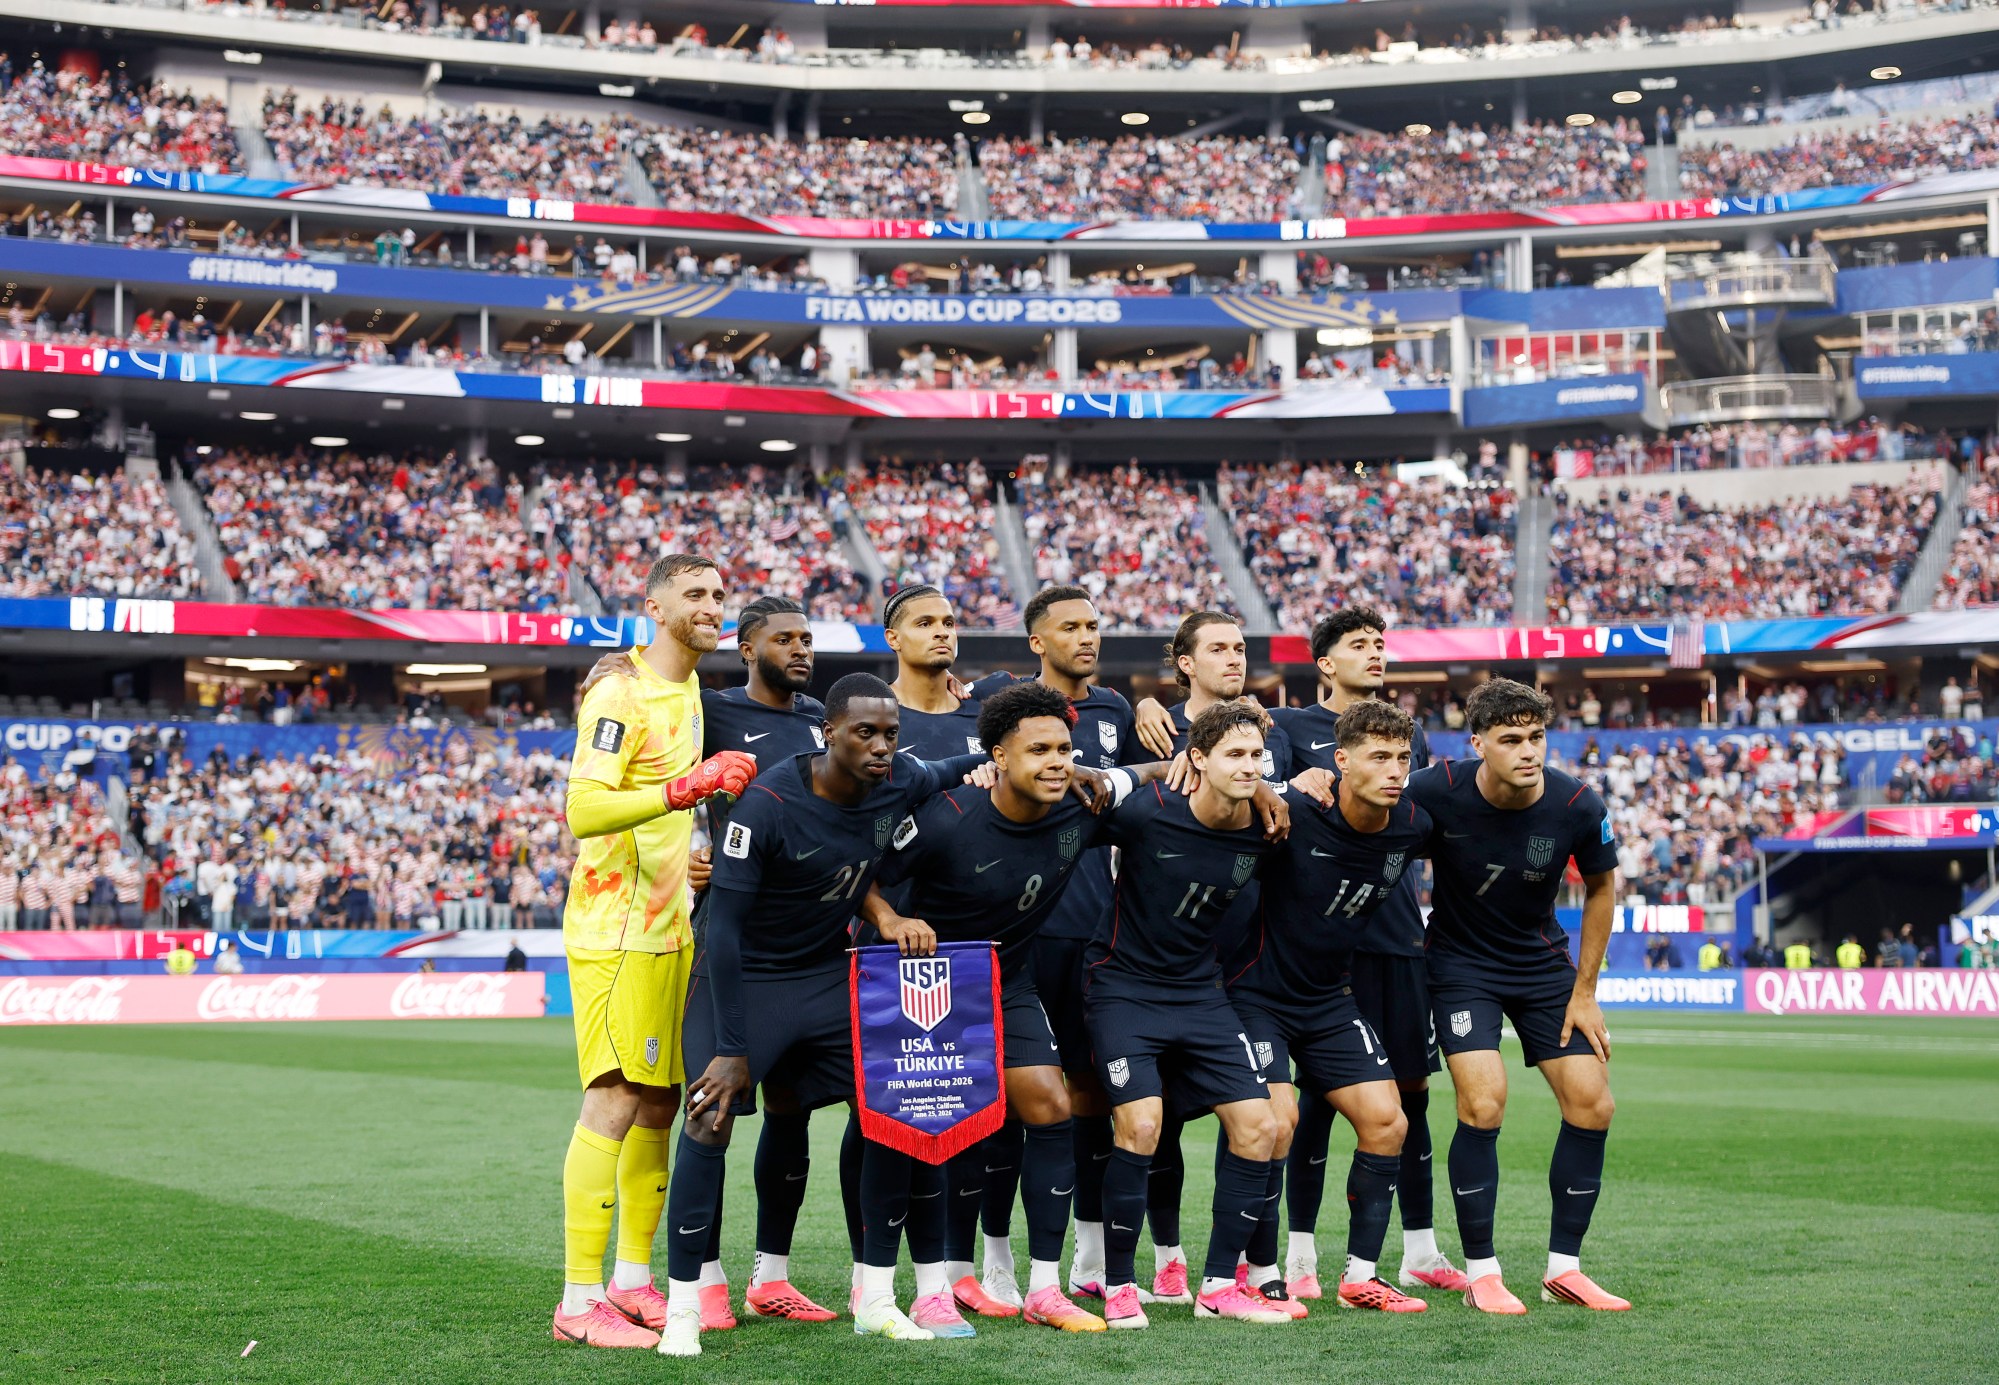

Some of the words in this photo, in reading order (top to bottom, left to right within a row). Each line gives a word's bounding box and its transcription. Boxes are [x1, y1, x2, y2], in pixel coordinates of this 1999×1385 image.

[806, 297, 864, 320] FIFA
[865, 298, 966, 322] WORLD
[968, 299, 1024, 322] CUP
[1025, 299, 1122, 323] 2026
[5, 723, 73, 750] CUP
[876, 816, 892, 832] USA
[1060, 828, 1078, 843] USA
[1531, 838, 1553, 851] USA
[1237, 855, 1256, 868] USA
[1388, 854, 1404, 866] USA
[820, 859, 869, 901] 21
[1475, 863, 1505, 896] 7
[1017, 874, 1043, 911] 8
[1173, 882, 1216, 918] 11
[1324, 879, 1374, 918] 14
[902, 961, 947, 989] USA
[1755, 970, 1867, 1015] QATAR
[1452, 1012, 1469, 1024] USA
[901, 1037, 934, 1053] USA
[894, 1054, 965, 1073] TÜRKIYE
[1109, 1059, 1126, 1072] USA
[888, 1080, 905, 1090] FIFA
[906, 1078, 933, 1088] World
[934, 1078, 951, 1088] Cup
[952, 1077, 973, 1086] 2026
[912, 1096, 936, 1104] Angeles
